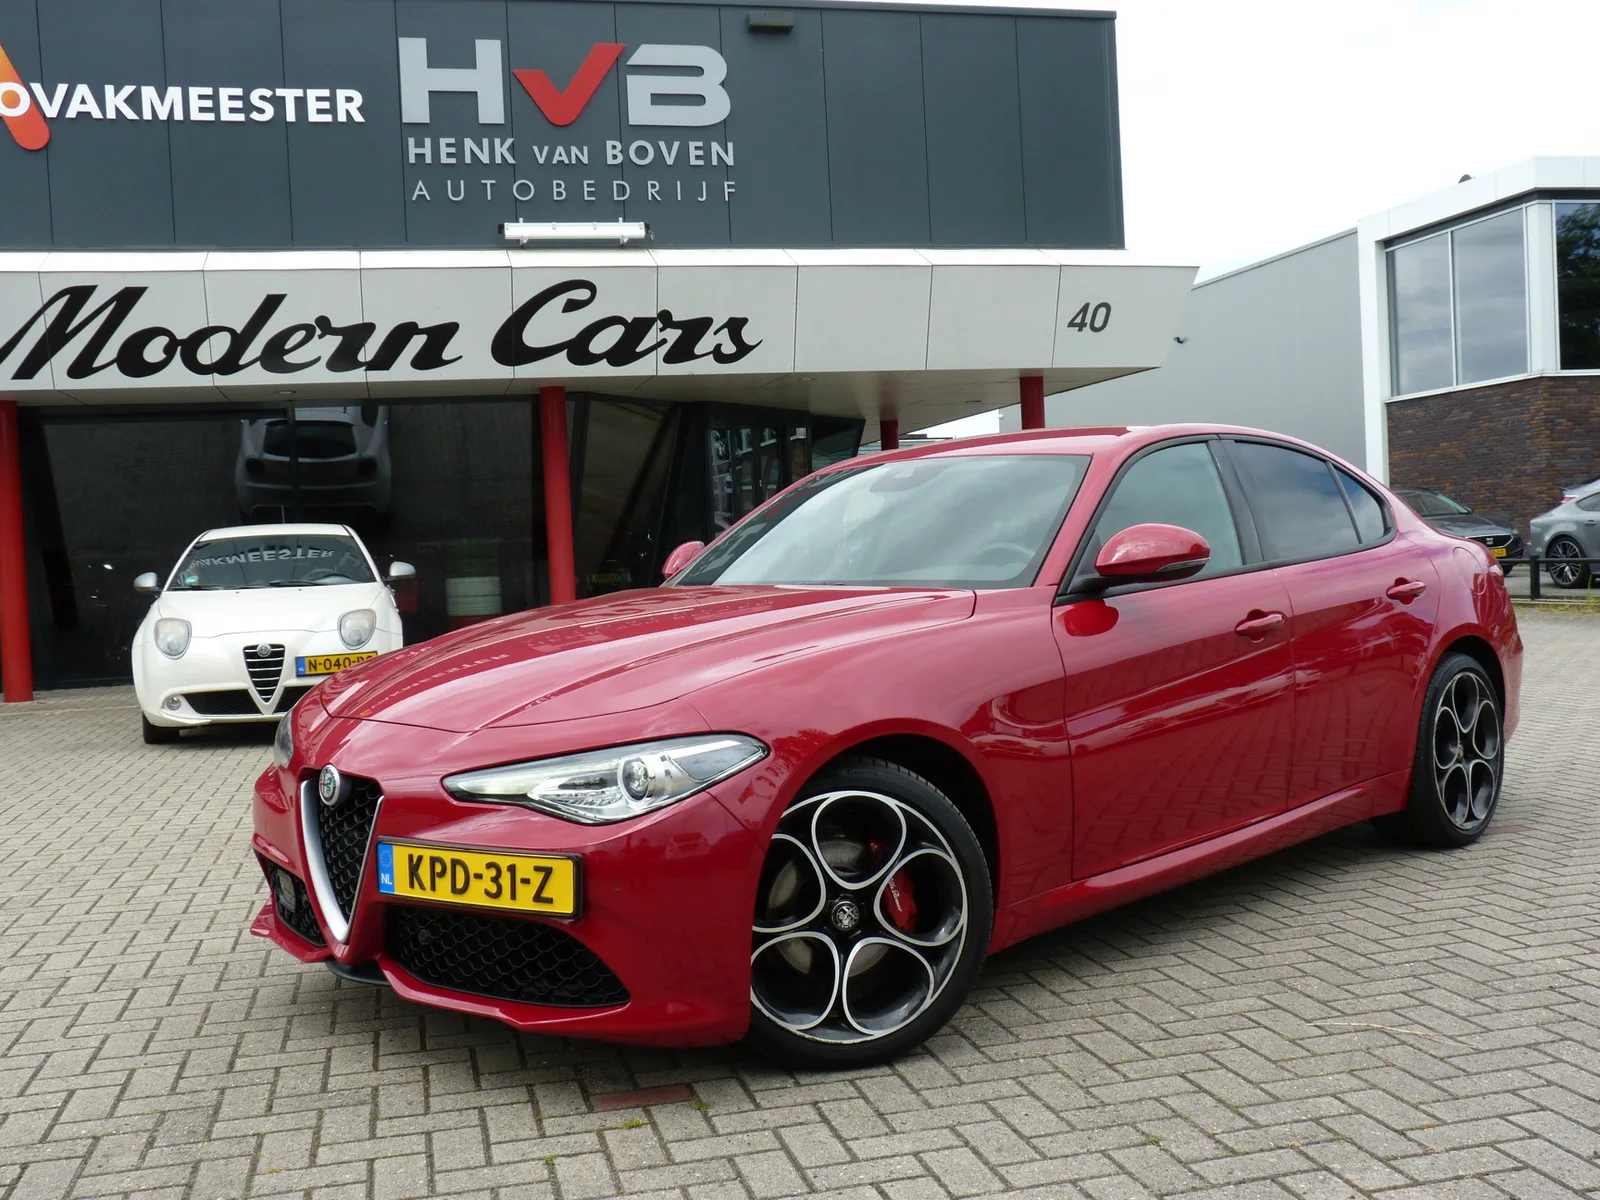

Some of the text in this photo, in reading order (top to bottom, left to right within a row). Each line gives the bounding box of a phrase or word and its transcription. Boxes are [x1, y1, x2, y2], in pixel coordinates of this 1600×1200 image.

[407, 137, 735, 167] HENK VAN BOVEN
[412, 180, 736, 202] AUTOBEDRIJF
[0, 279, 763, 381] Modern Cars
[1066, 301, 1112, 333] 40
[381, 853, 554, 904] NL KPD-31-Z
